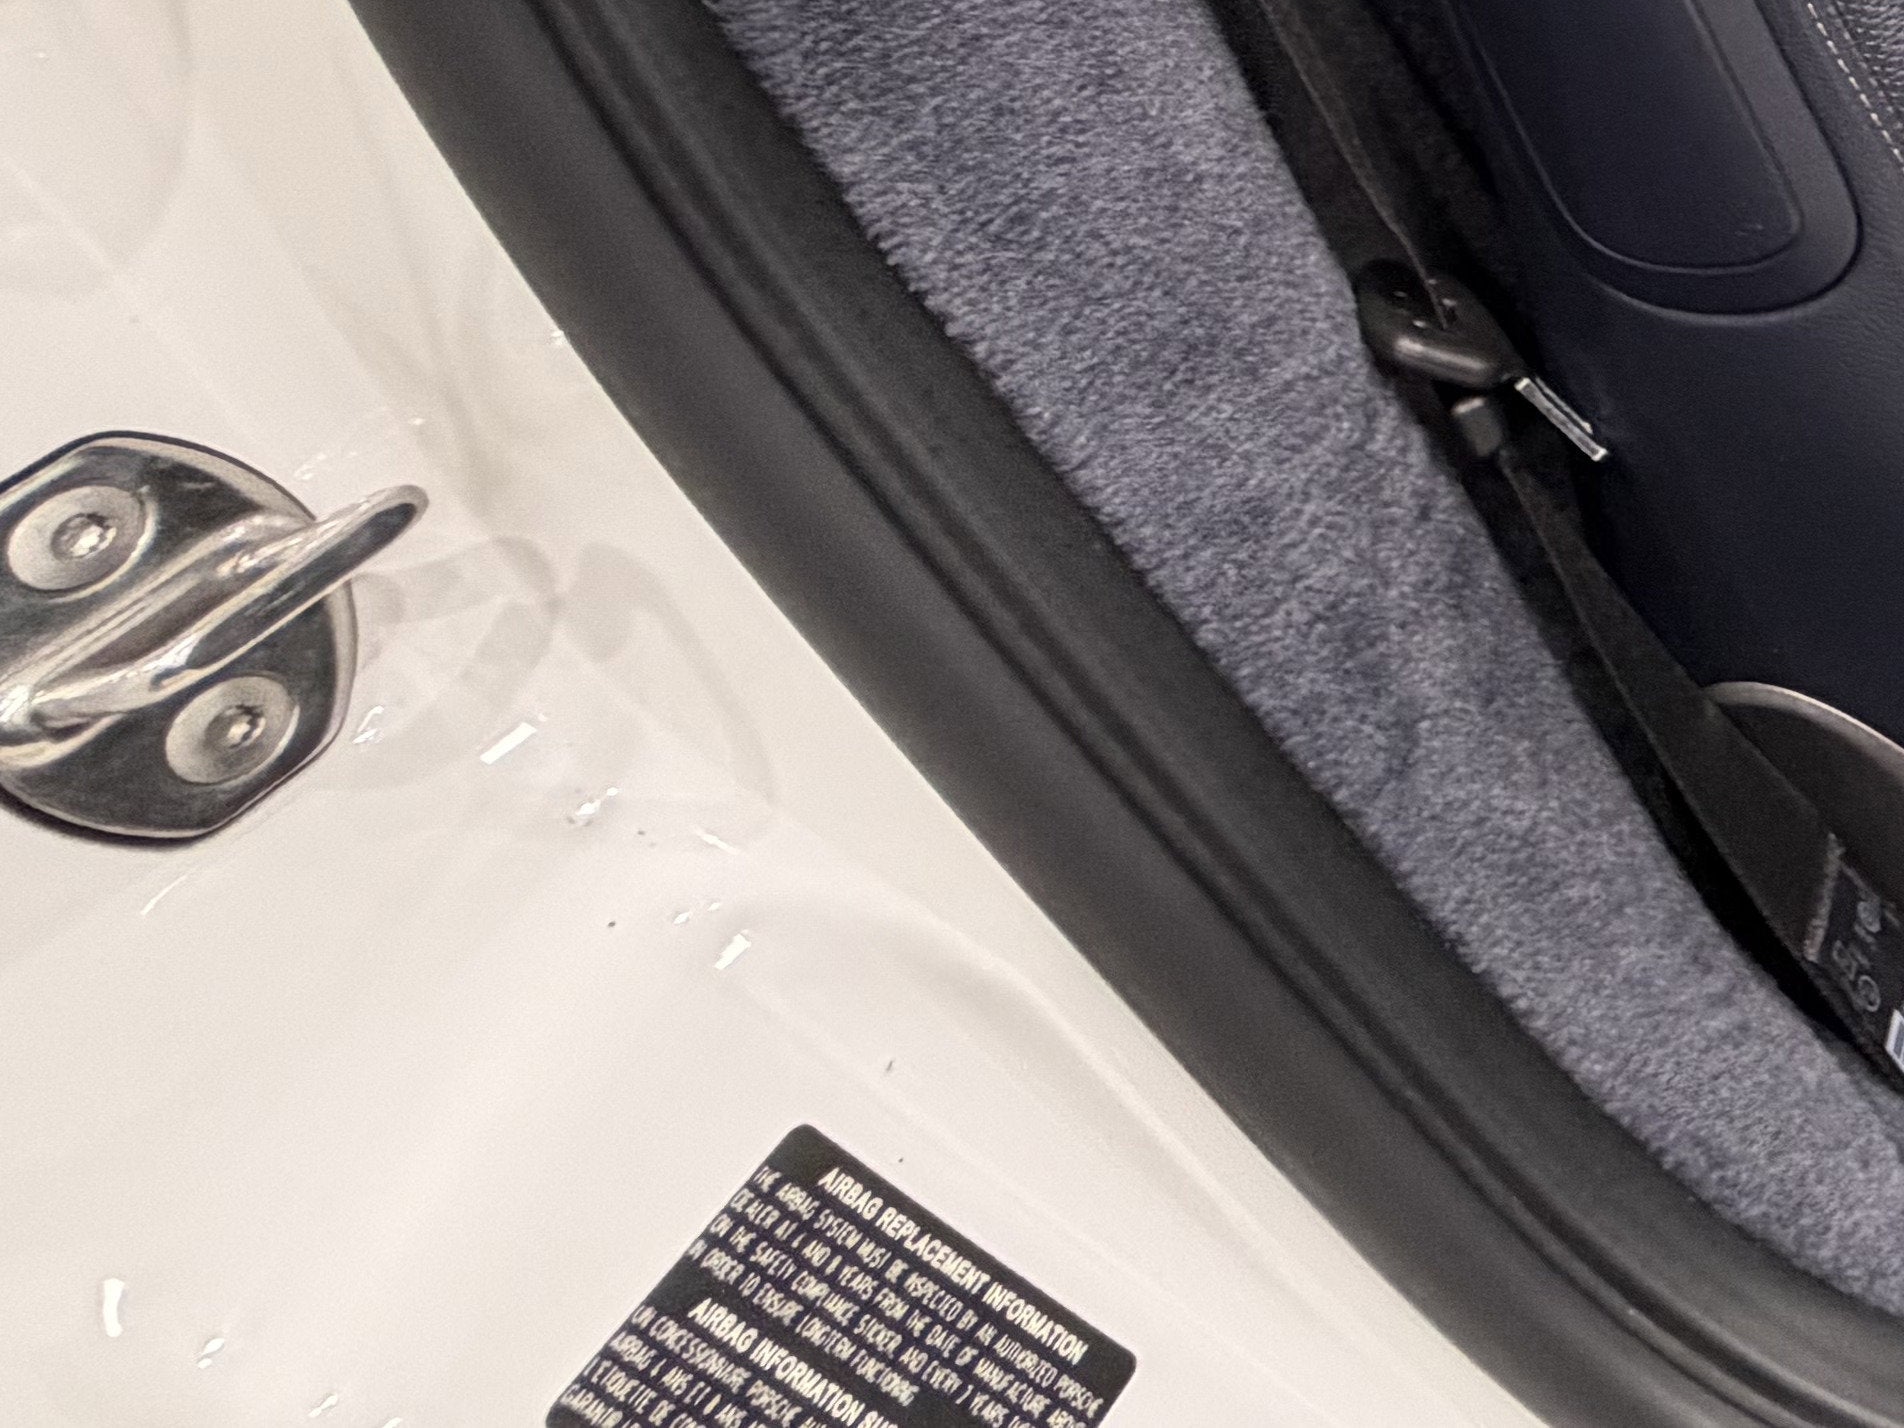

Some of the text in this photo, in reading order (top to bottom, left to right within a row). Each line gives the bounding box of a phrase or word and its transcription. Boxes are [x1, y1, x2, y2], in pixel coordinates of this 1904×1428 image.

[727, 1186, 780, 1229] DEALER
[802, 1240, 831, 1267] AND
[838, 1265, 879, 1300] YEARS
[873, 1288, 909, 1320] FROM
[749, 1241, 797, 1279] SAFETY
[775, 1183, 820, 1220] AIRBAG
[813, 1209, 863, 1249] SYSTEM
[856, 1238, 891, 1269] MUST
[904, 1272, 963, 1321] INSPECTED
[818, 1167, 1089, 1365] AIRBAG REPLACEMENT INFORMATION
[687, 1298, 758, 1353] AIRBAG
[749, 1337, 865, 1427] INFORMATION
